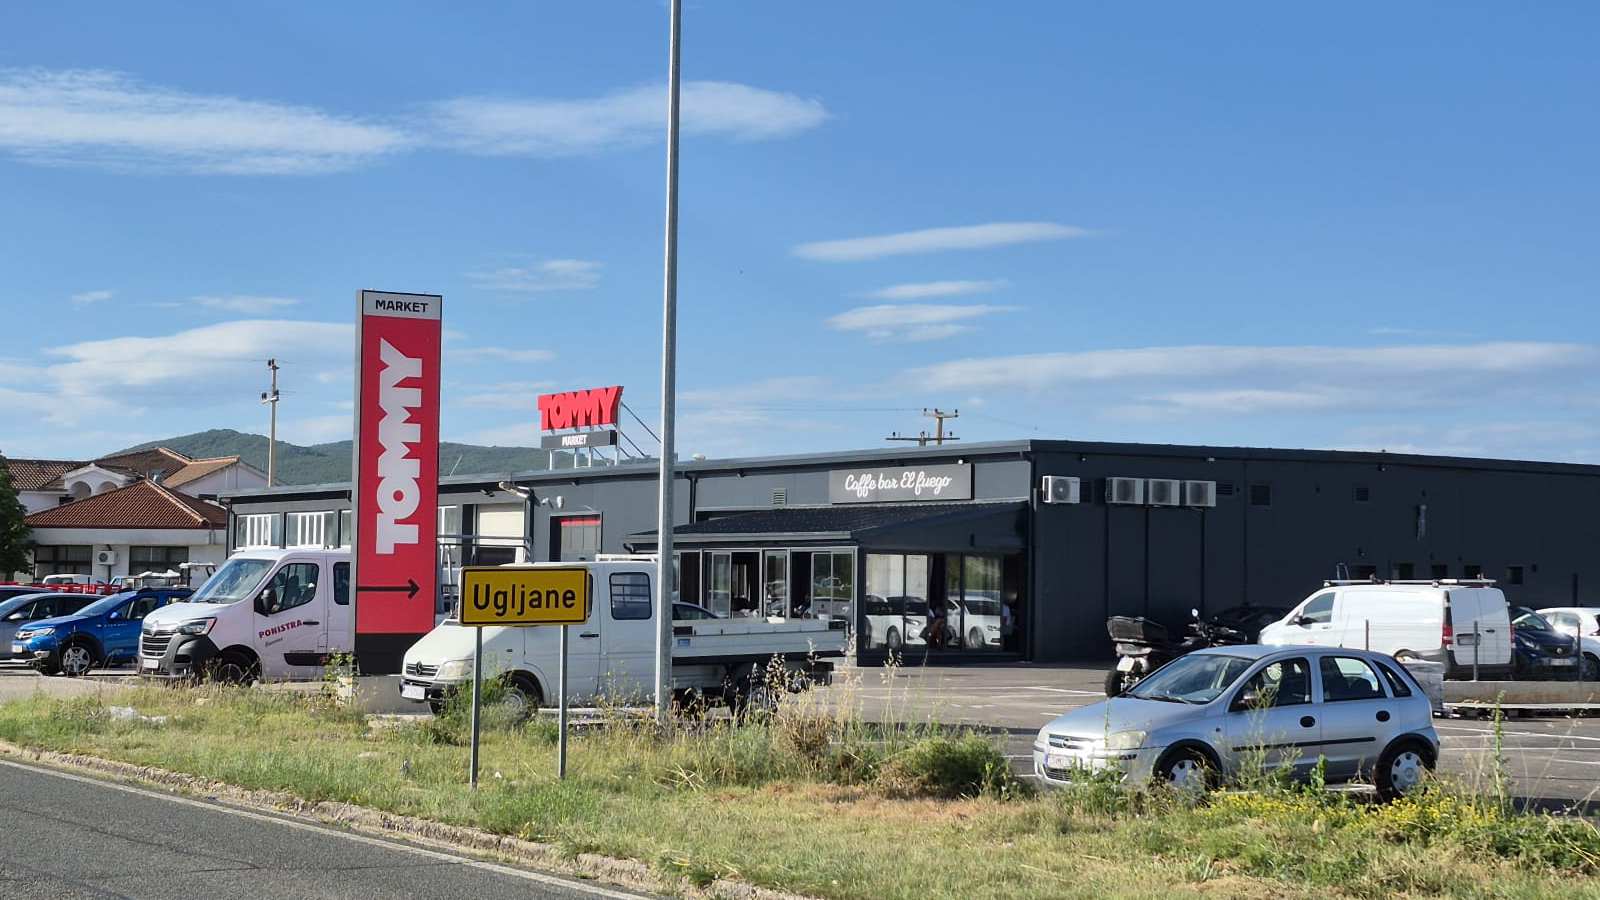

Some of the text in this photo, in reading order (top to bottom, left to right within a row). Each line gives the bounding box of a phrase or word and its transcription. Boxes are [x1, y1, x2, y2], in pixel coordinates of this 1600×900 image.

[375, 299, 428, 313] MARKET
[538, 386, 622, 431] TOMMY
[375, 337, 423, 555] TOMMY
[561, 434, 588, 446] MARKET
[845, 471, 952, 498] Caffe bar El fuego
[473, 583, 576, 617] Ugljane
[259, 619, 303, 639] PONISTRA
